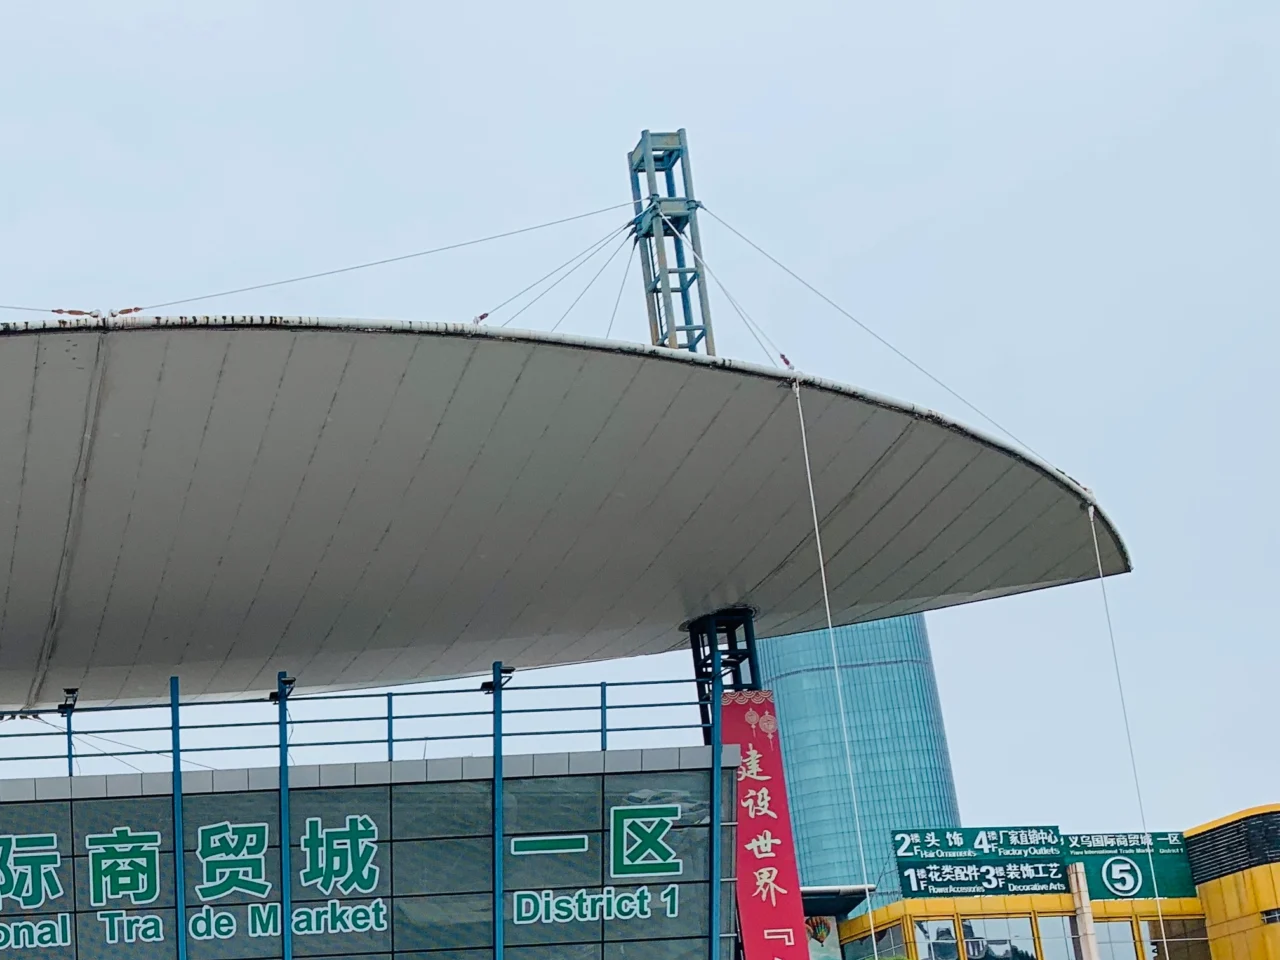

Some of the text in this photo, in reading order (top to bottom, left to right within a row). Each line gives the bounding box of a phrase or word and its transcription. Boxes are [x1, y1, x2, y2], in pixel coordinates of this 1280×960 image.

[511, 804, 683, 878] 一区
[895, 833, 914, 857] 2
[974, 830, 992, 854] 4
[1068, 833, 1182, 847] 义乌国际商贸城 一区
[904, 868, 919, 892] 1
[926, 864, 980, 881] 花类配件
[980, 865, 998, 889] 3
[1006, 863, 1062, 879] 装饰工艺
[513, 884, 652, 924] District
[660, 883, 679, 918] 1
